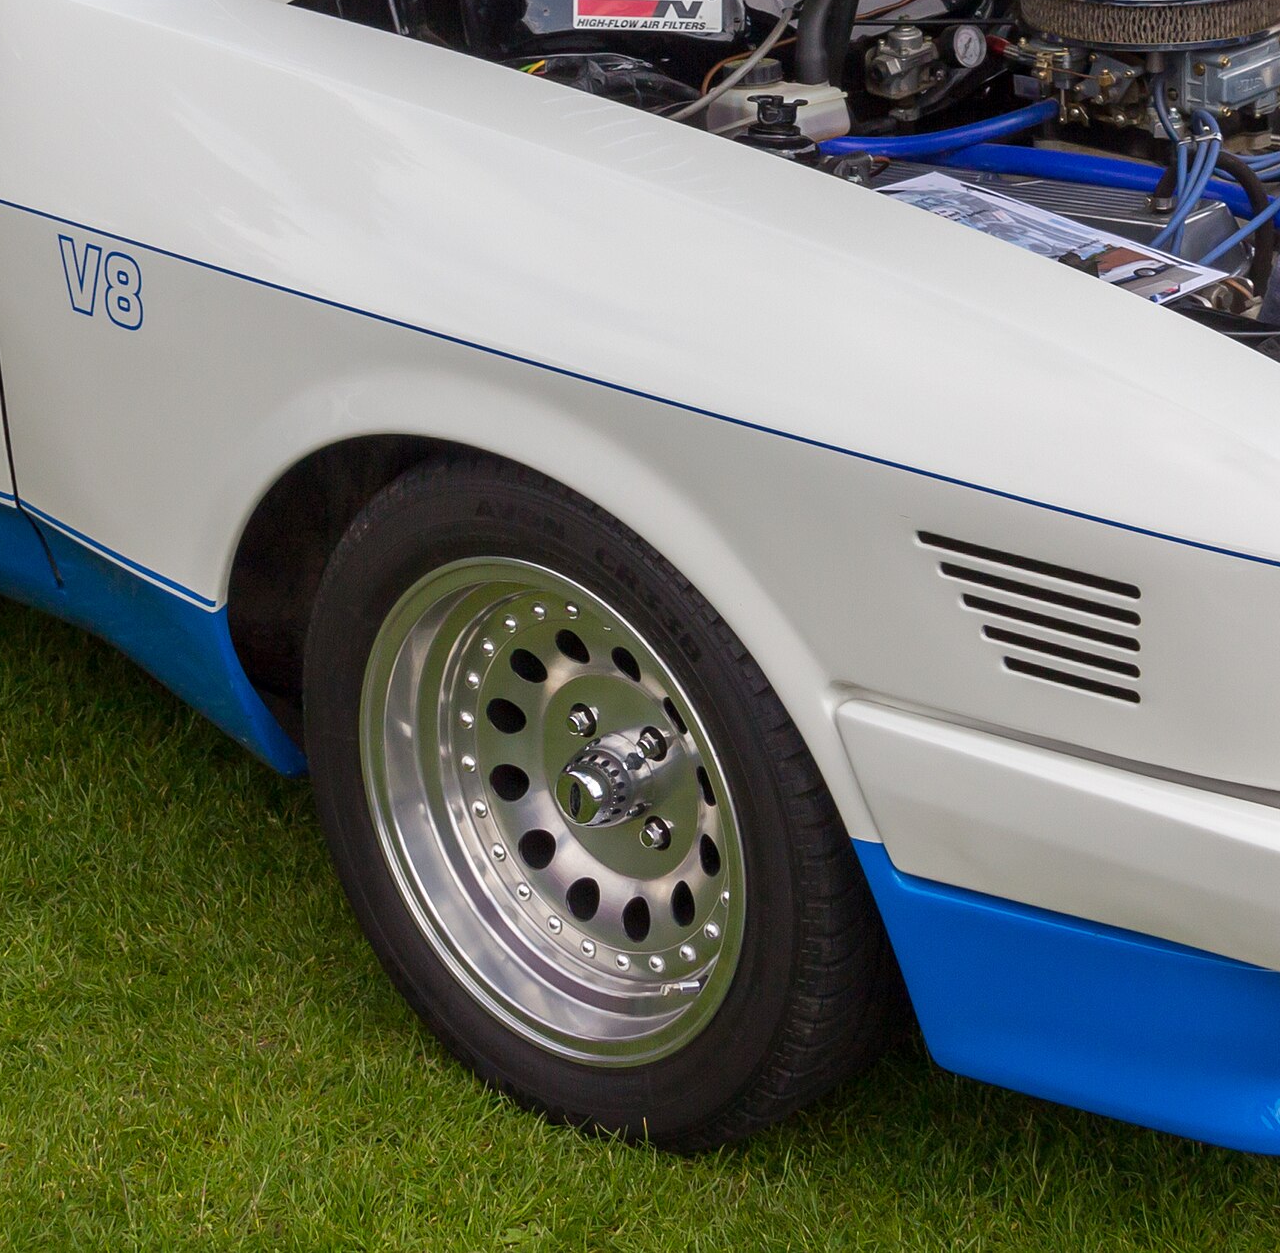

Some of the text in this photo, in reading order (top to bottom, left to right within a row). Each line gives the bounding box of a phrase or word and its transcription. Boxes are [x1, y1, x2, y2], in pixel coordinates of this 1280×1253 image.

[577, 18, 706, 31] HIGH-FLOW AIR FILTERS
[58, 233, 144, 331] V8
